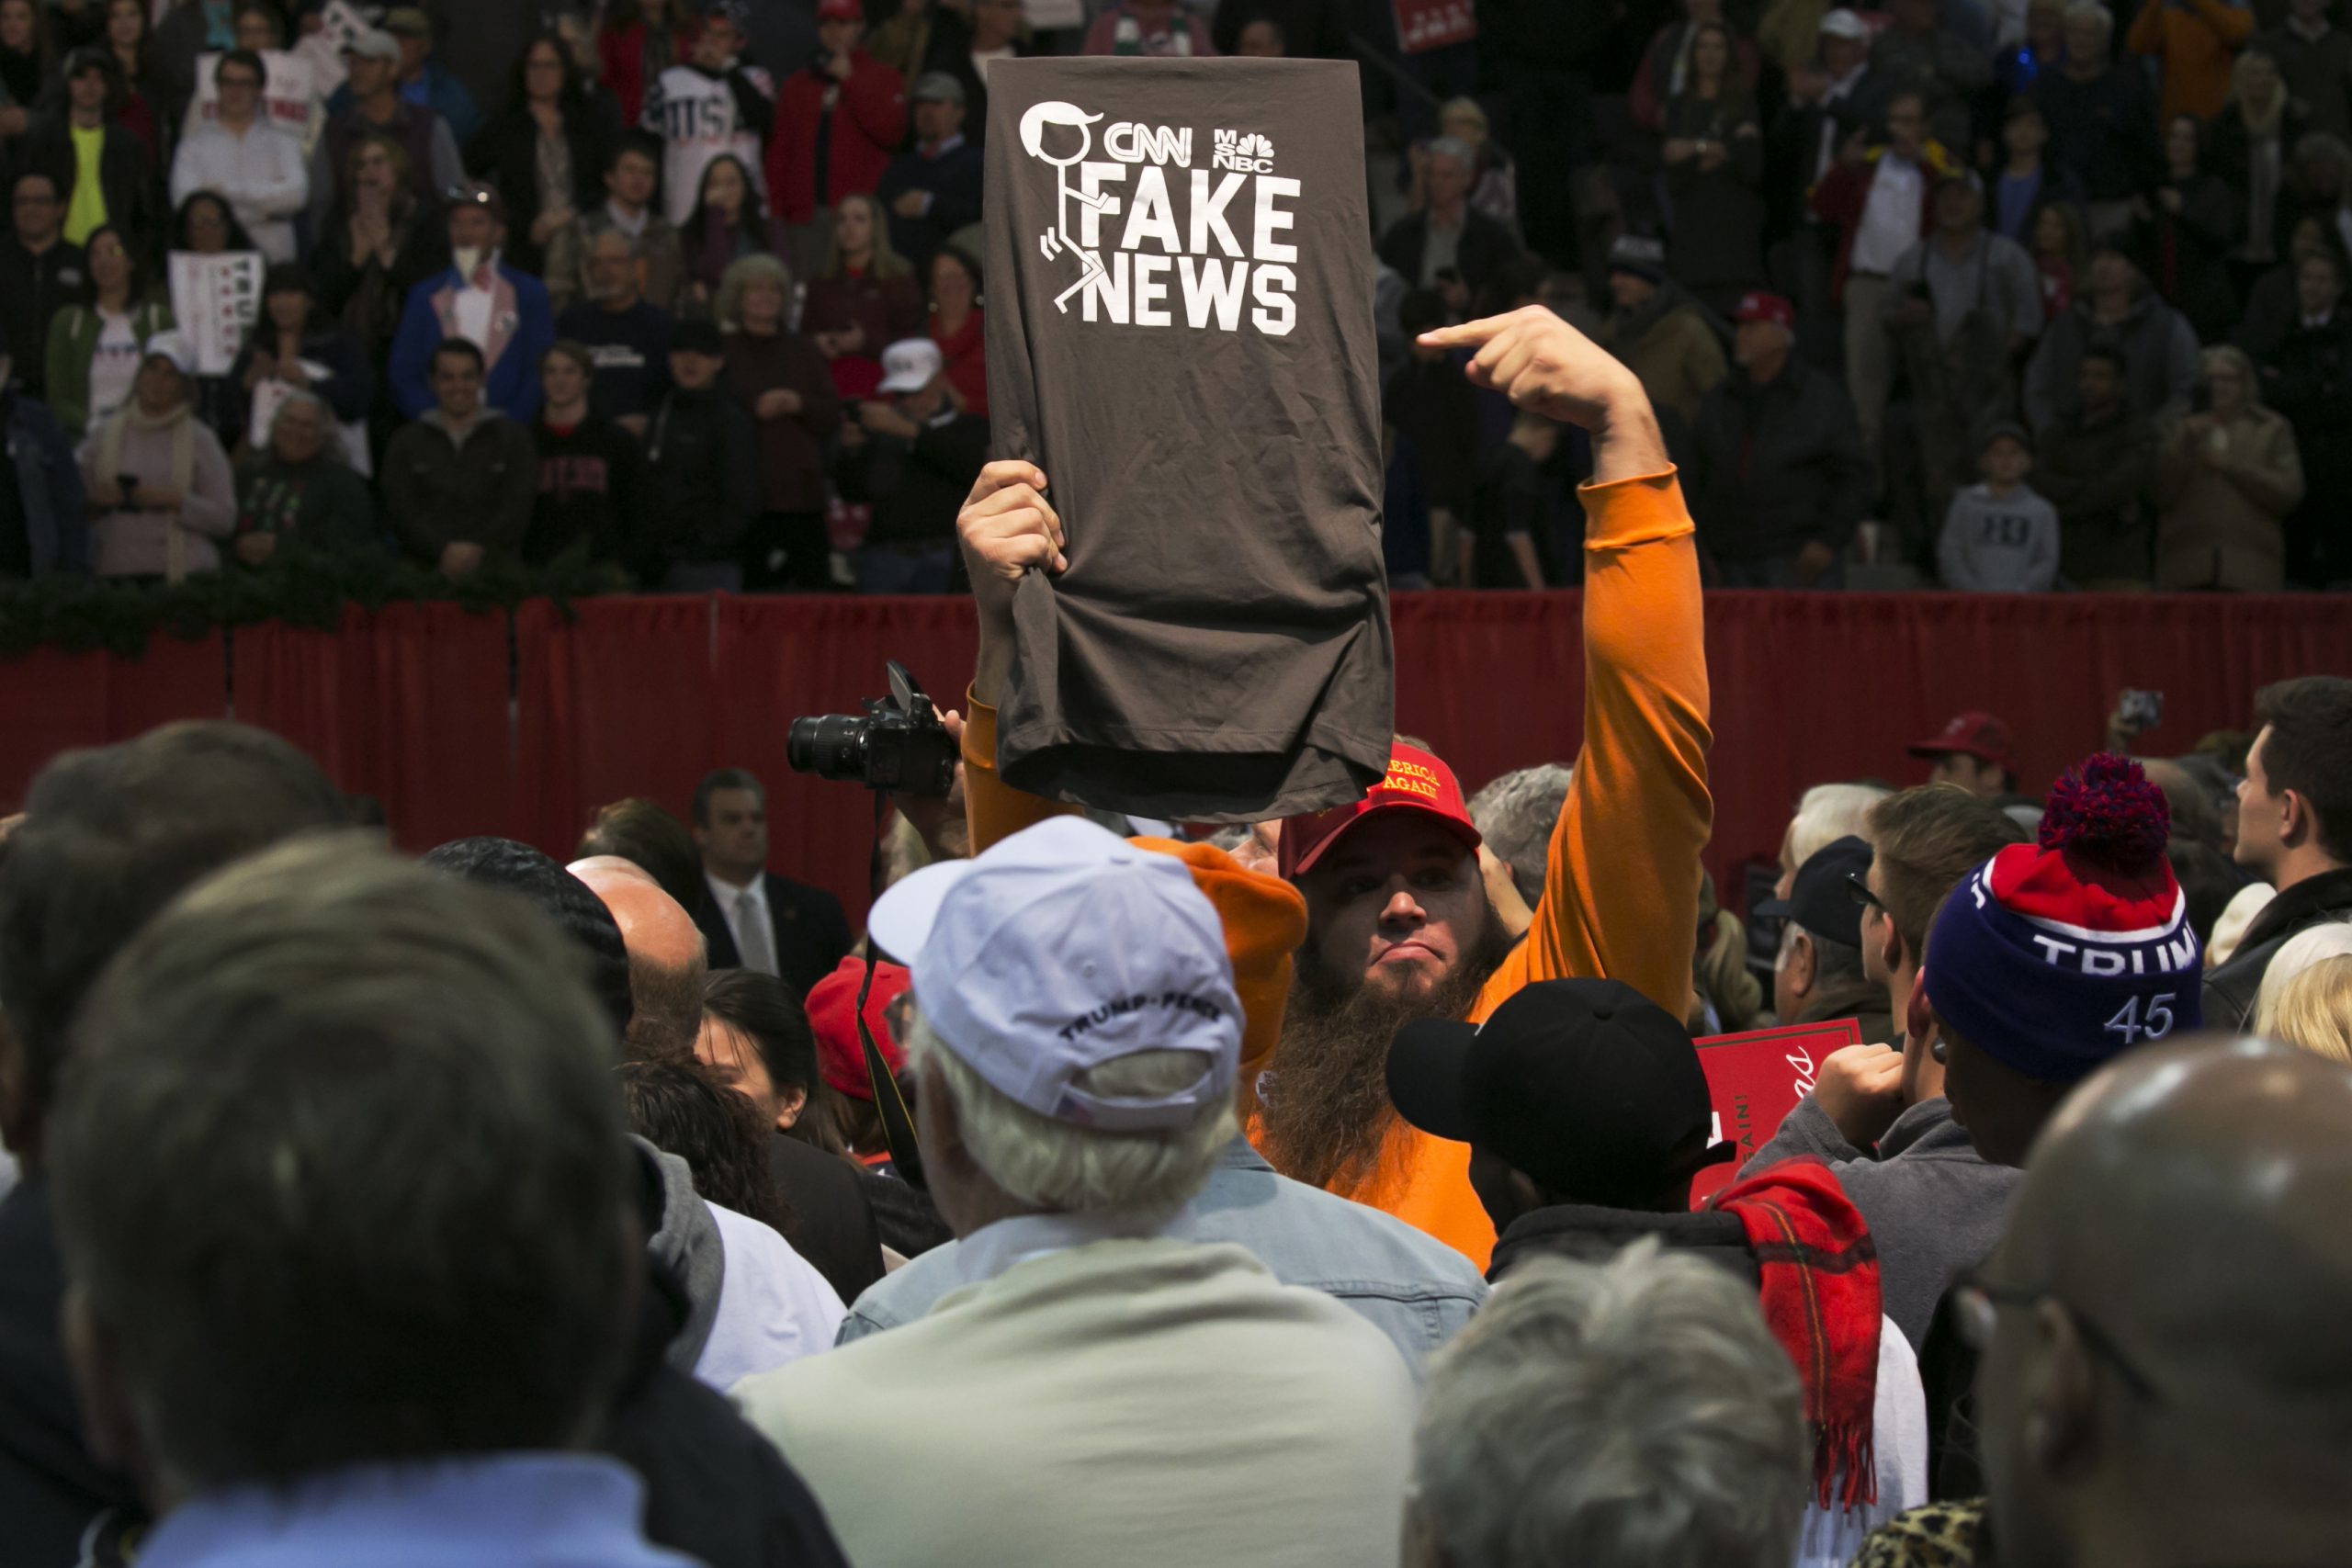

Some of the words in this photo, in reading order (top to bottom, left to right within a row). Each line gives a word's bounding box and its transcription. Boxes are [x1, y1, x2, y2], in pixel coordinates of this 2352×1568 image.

[1103, 121, 1193, 168] CNN
[1080, 161, 1301, 264] FAKE
[1082, 250, 1297, 336] NEWS
[1387, 759, 1441, 787] ERICA
[2033, 920, 2197, 976] TRUM
[2103, 992, 2177, 1044] 45
